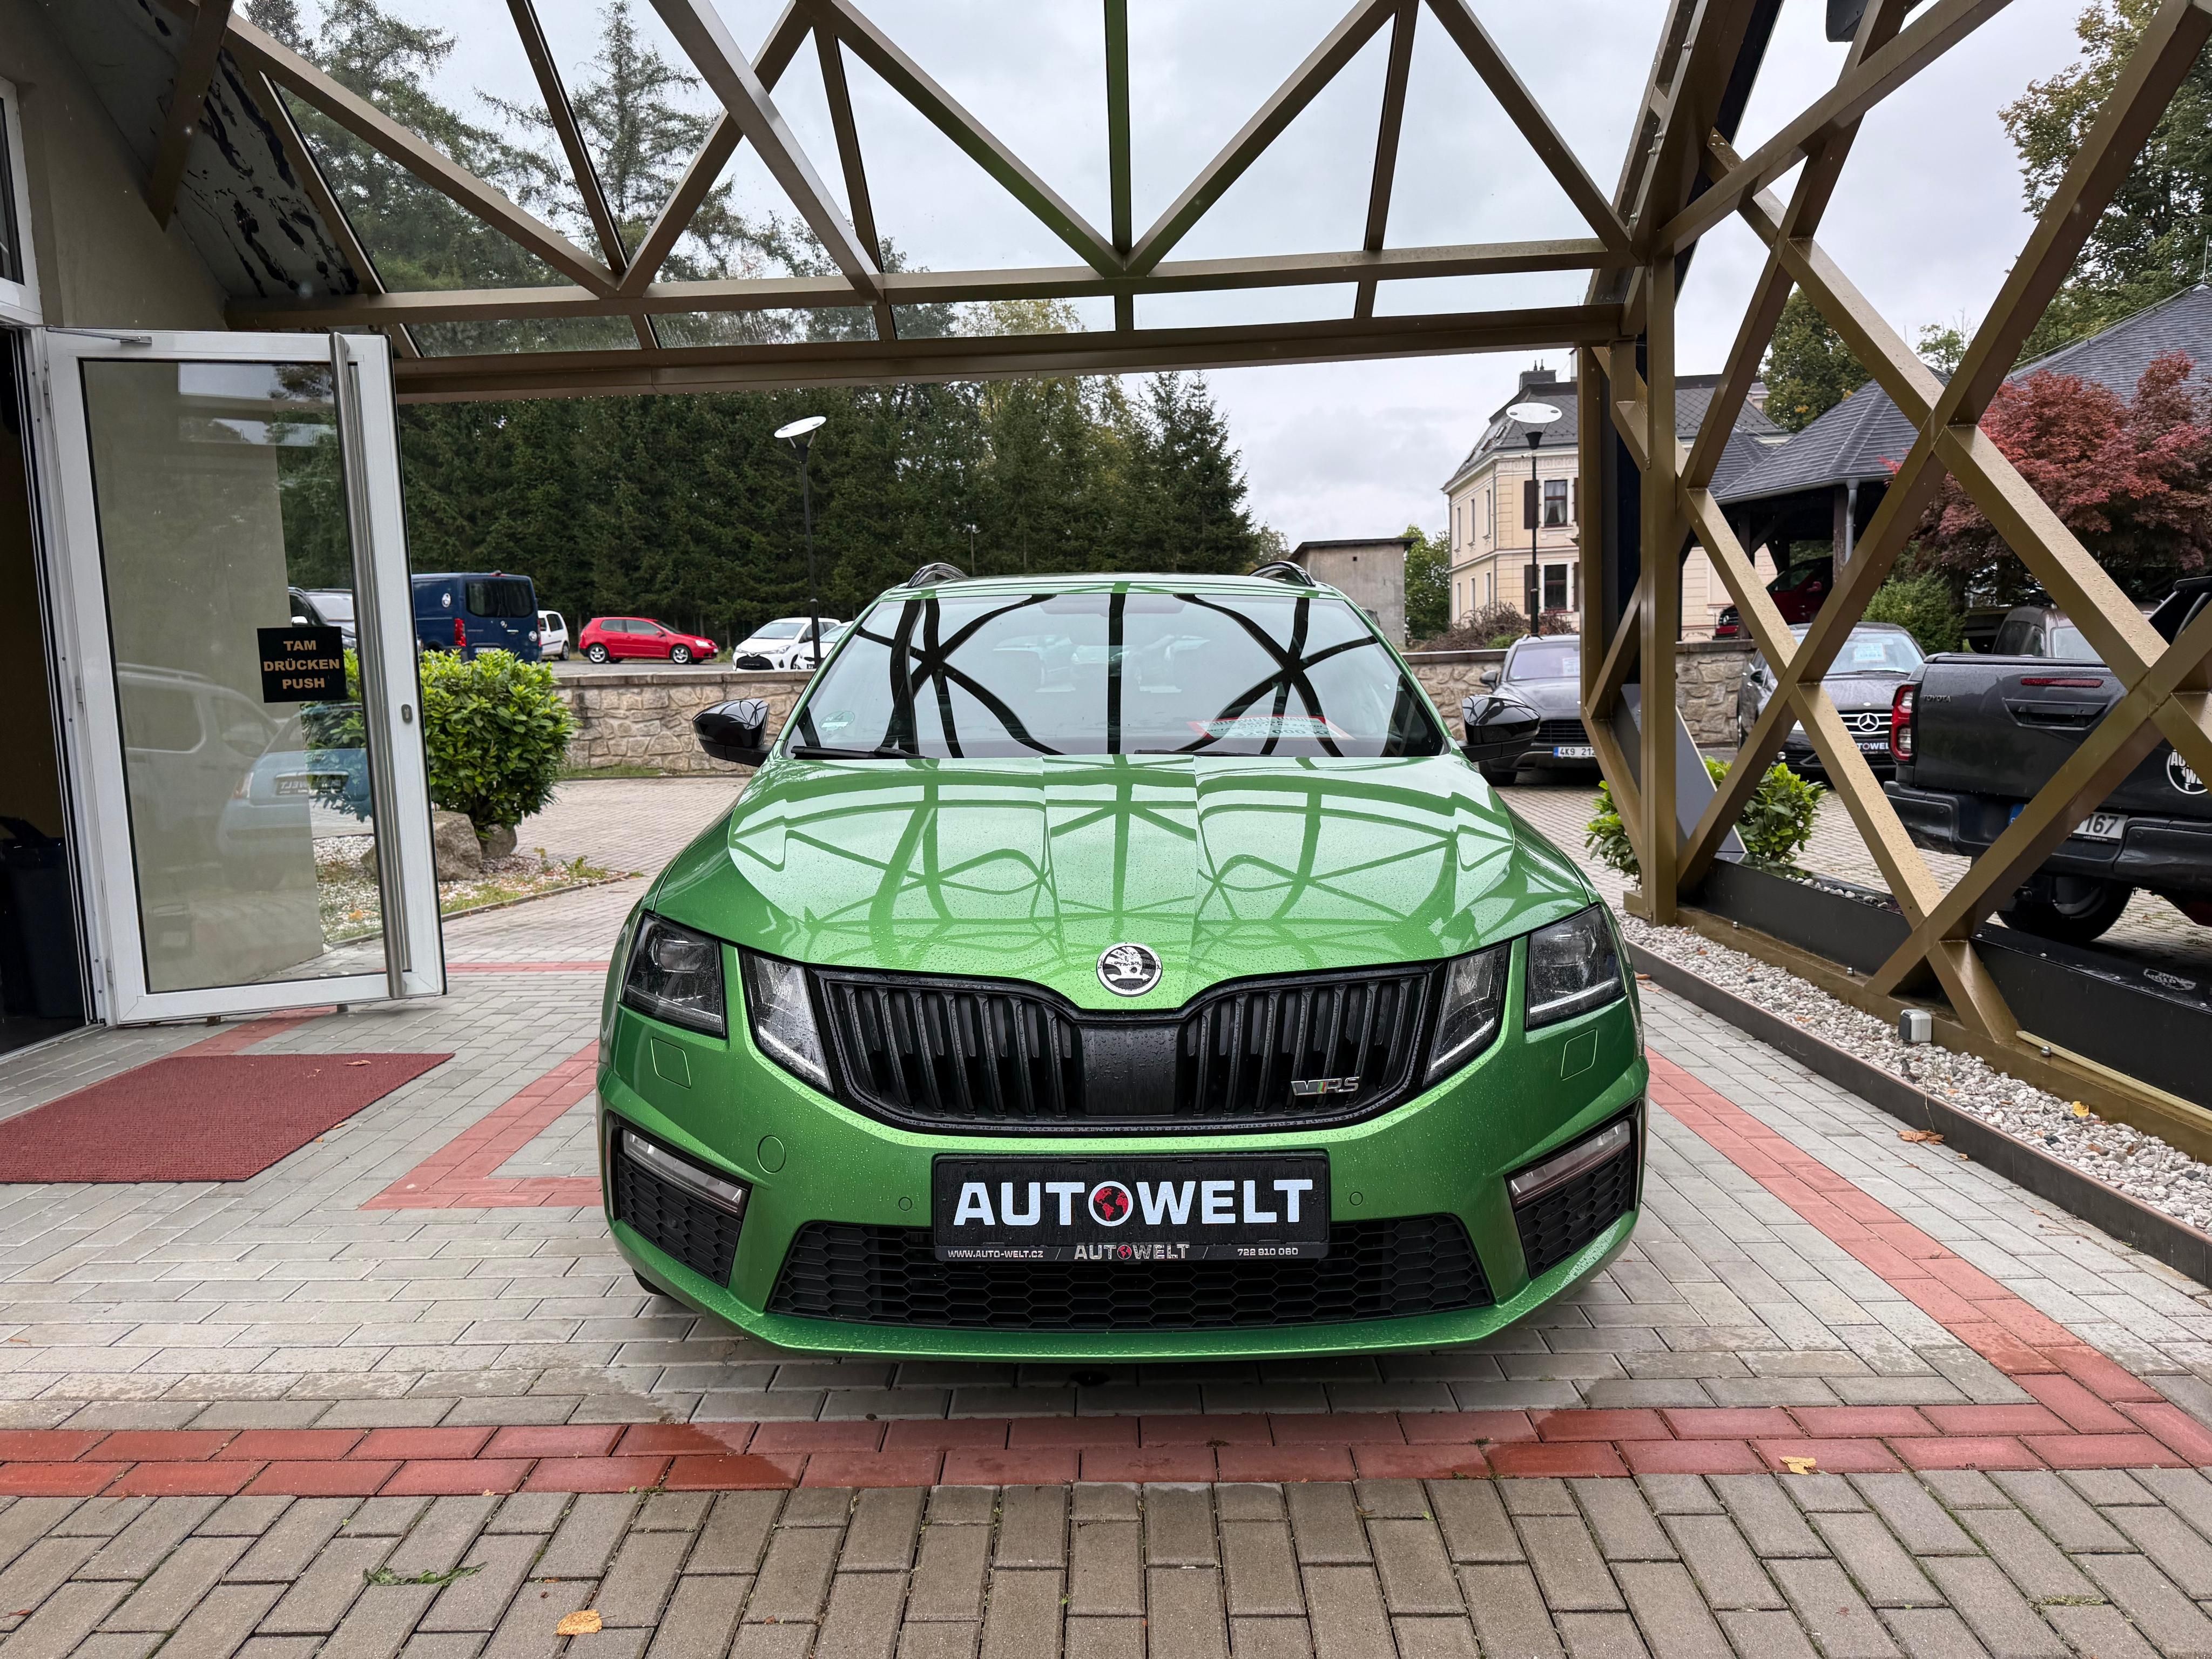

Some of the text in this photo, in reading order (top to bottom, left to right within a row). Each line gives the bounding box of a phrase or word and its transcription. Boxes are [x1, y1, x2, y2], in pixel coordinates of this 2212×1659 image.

[284, 640, 316, 651] TAM
[264, 658, 340, 672] DRÜCKEN
[282, 678, 325, 690] PUSH
[1924, 694, 1951, 703] TOYOTA
[1857, 742, 1889, 750] TOWEL
[953, 1179, 1313, 1227] AUTOWELT
[1074, 1244, 1190, 1260] AUTOWELT
